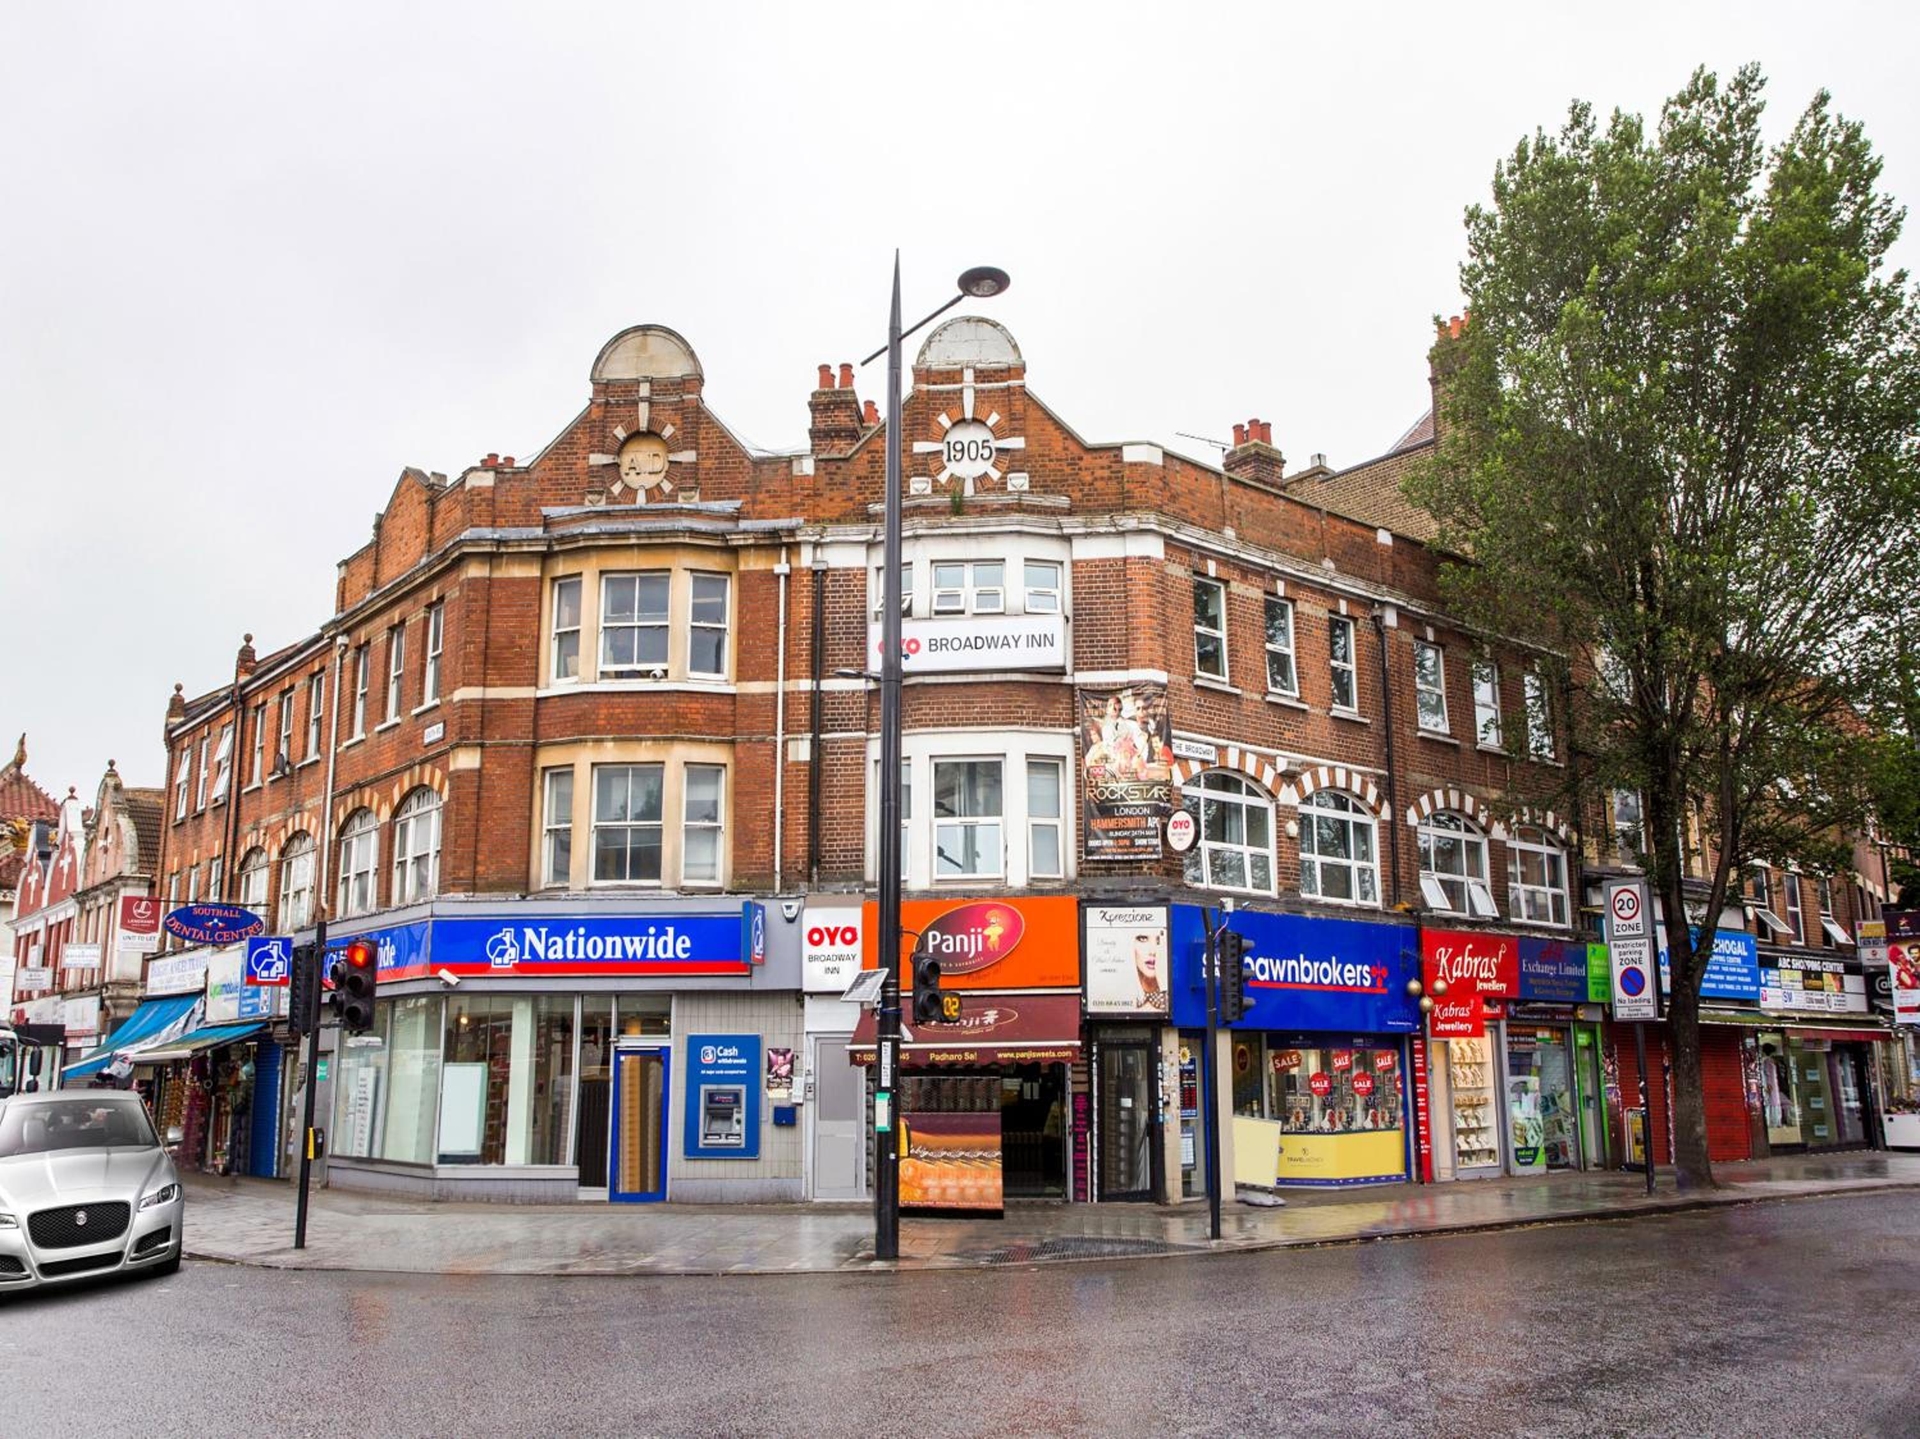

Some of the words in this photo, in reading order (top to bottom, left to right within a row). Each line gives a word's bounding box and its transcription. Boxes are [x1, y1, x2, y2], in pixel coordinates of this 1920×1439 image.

[946, 439, 993, 462] 1905
[928, 634, 1021, 652] BROADWAY
[1026, 634, 1054, 648] INN
[1185, 745, 1213, 755] BROADWAY
[1086, 786, 1171, 802] ROCKSTARS
[1114, 807, 1150, 816] LONDON
[1090, 817, 1146, 829] HAMMERSMITH
[1172, 820, 1190, 829] OYO
[1617, 898, 1635, 911] 20
[192, 907, 241, 918] SOUTHALL
[166, 916, 213, 941] DENTAL
[214, 921, 262, 942] CENTRE
[1615, 923, 1641, 933] ZONE
[808, 926, 858, 947] OYO
[522, 927, 691, 960] Nationwide
[928, 928, 983, 958] Panji
[808, 953, 857, 963] BROADWAY
[1619, 949, 1643, 957] parking
[1620, 957, 1643, 966] ZONE
[1778, 957, 1791, 969] ABC
[1822, 961, 1845, 973] CENTRE
[825, 966, 840, 974] INN
[1522, 959, 1557, 976] Exchange
[1558, 962, 1586, 977] Limited
[1476, 979, 1507, 993] Jewellery
[943, 996, 959, 1017] 02
[1628, 998, 1651, 1006] loading
[1435, 1021, 1473, 1032] Jewellery
[717, 1046, 738, 1057] Cash
[929, 1052, 963, 1061] Padharo
[996, 1050, 1072, 1059] www.panjisweets.com
[1275, 1054, 1299, 1069] SALE
[1333, 1056, 1350, 1068] SALE
[1376, 1056, 1393, 1068] SALE
[1311, 1080, 1329, 1088] SALE
[1354, 1080, 1371, 1088] SALE
